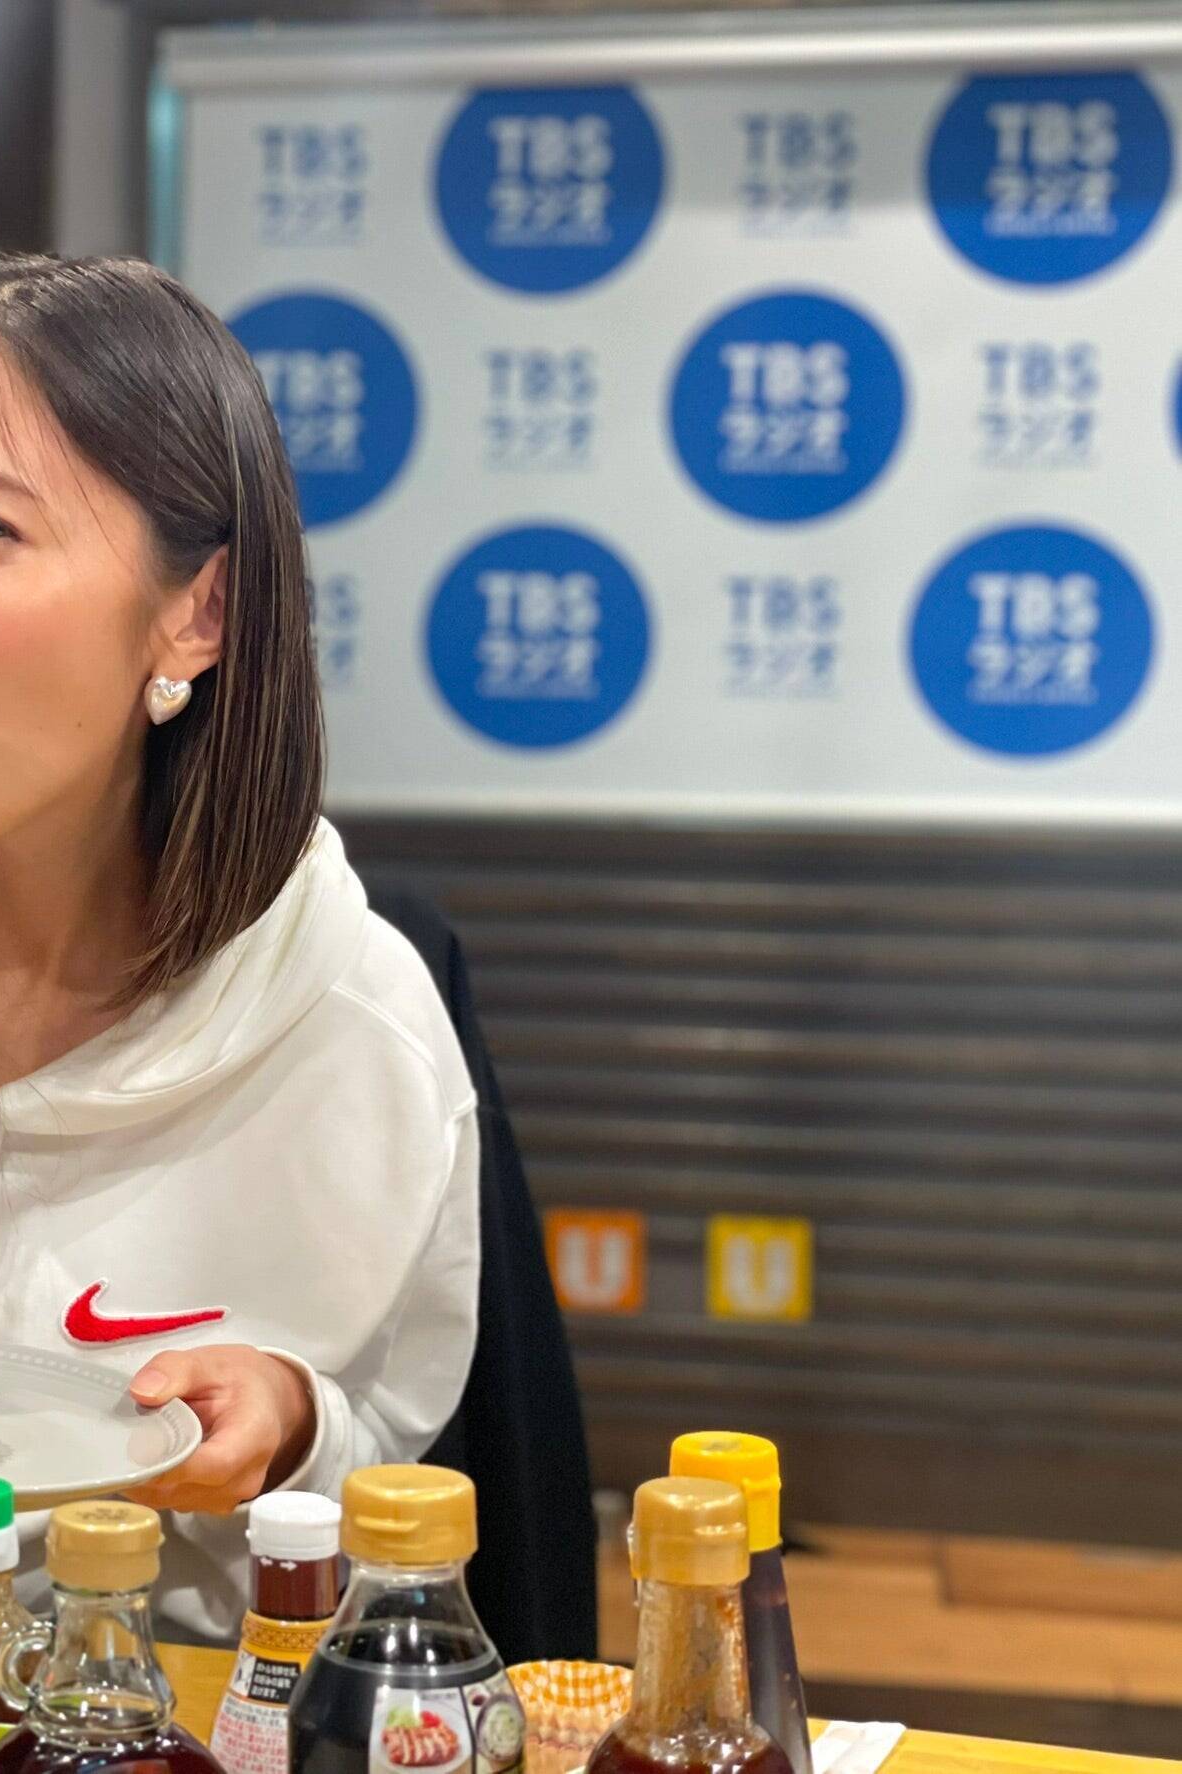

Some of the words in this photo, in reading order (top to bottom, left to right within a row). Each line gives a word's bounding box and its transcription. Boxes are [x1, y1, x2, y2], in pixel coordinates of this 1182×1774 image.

[489, 115, 612, 178] TBS
[985, 101, 1118, 167] TBS
[721, 341, 850, 406] TBS
[476, 571, 601, 635] TBS
[968, 572, 1101, 638] TBS
